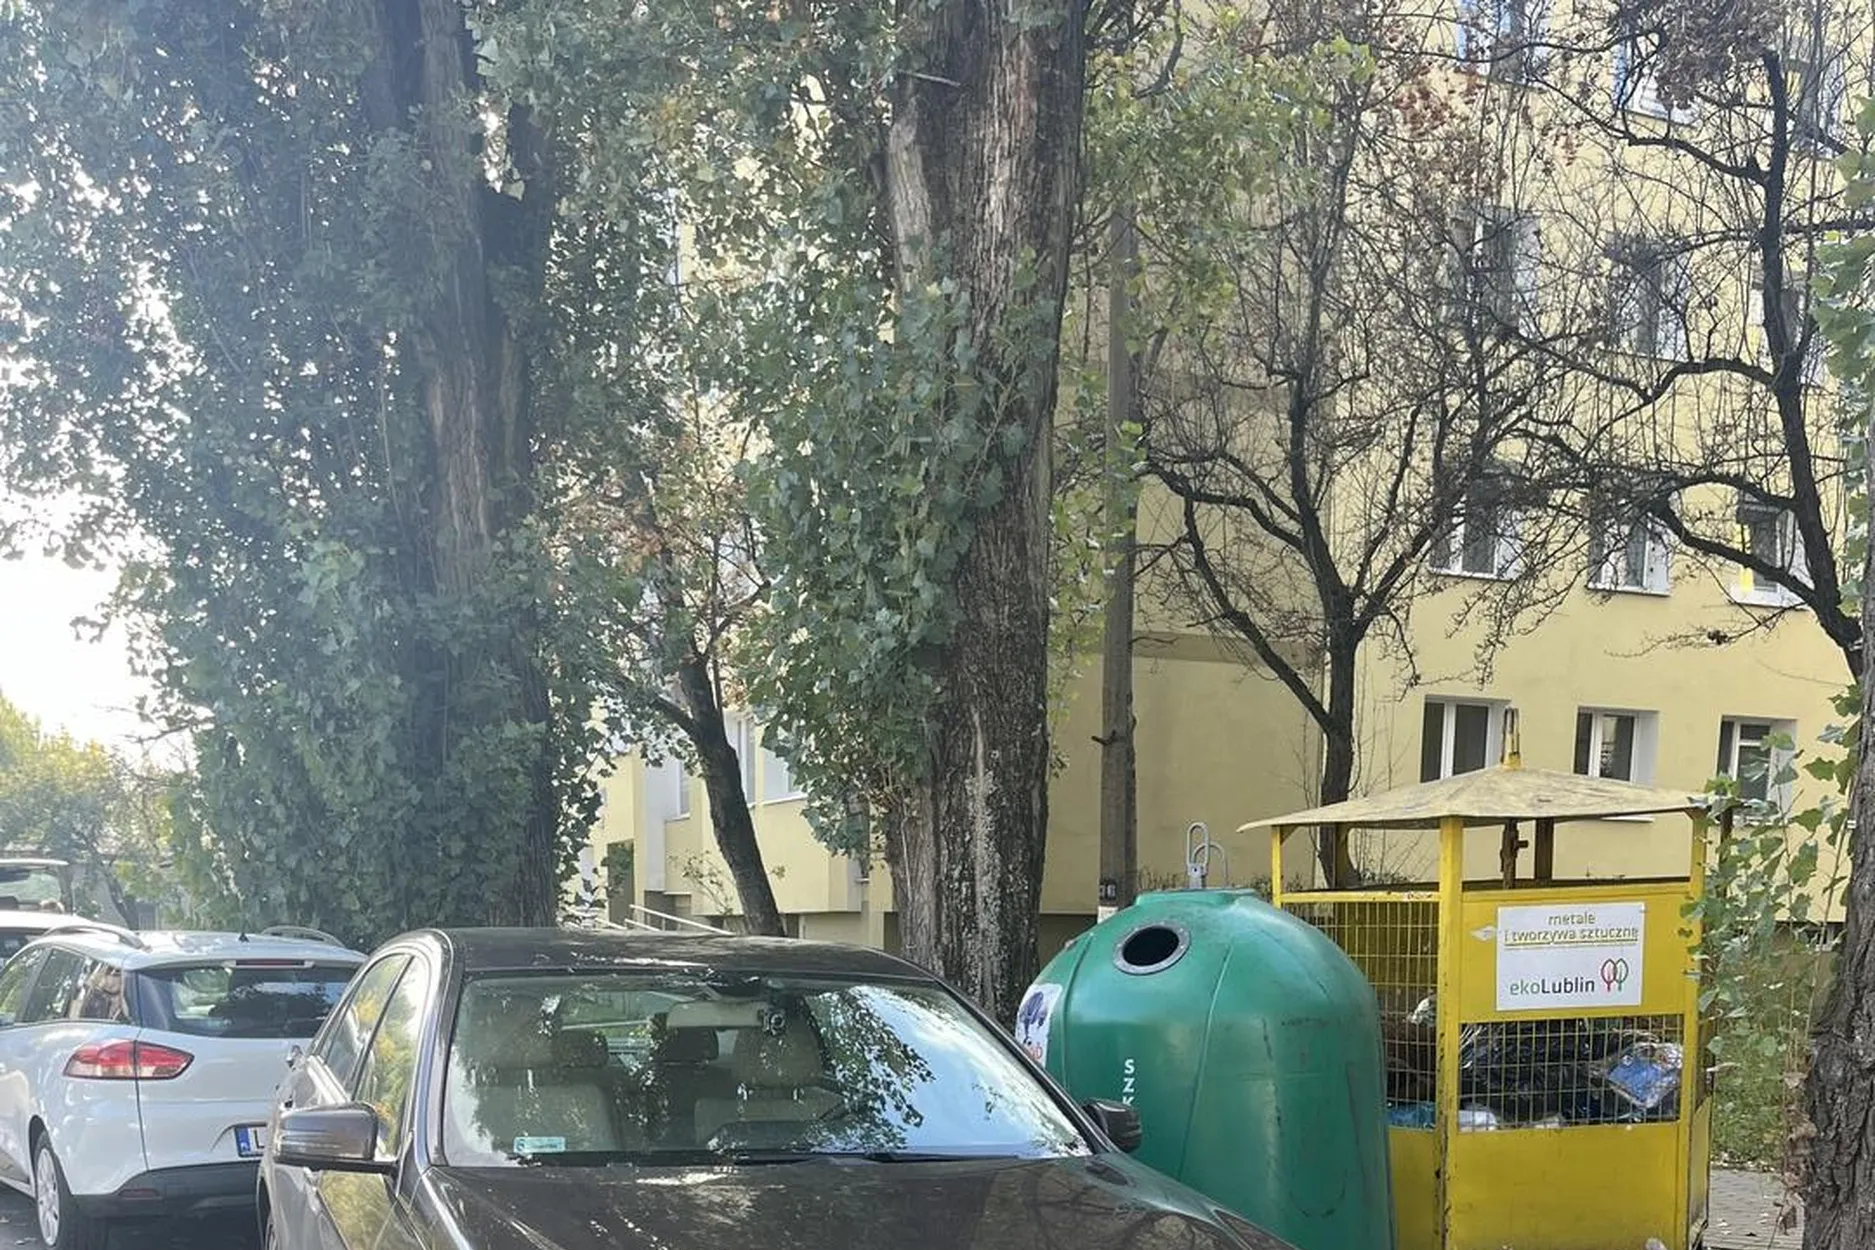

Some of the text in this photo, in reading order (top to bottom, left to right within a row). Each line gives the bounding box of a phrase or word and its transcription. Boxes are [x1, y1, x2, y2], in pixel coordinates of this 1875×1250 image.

[1548, 911, 1596, 926] metale
[1512, 929, 1576, 942] tworzywa
[1580, 926, 1639, 939] sztuczne
[1509, 976, 1595, 996] ekoLublin
